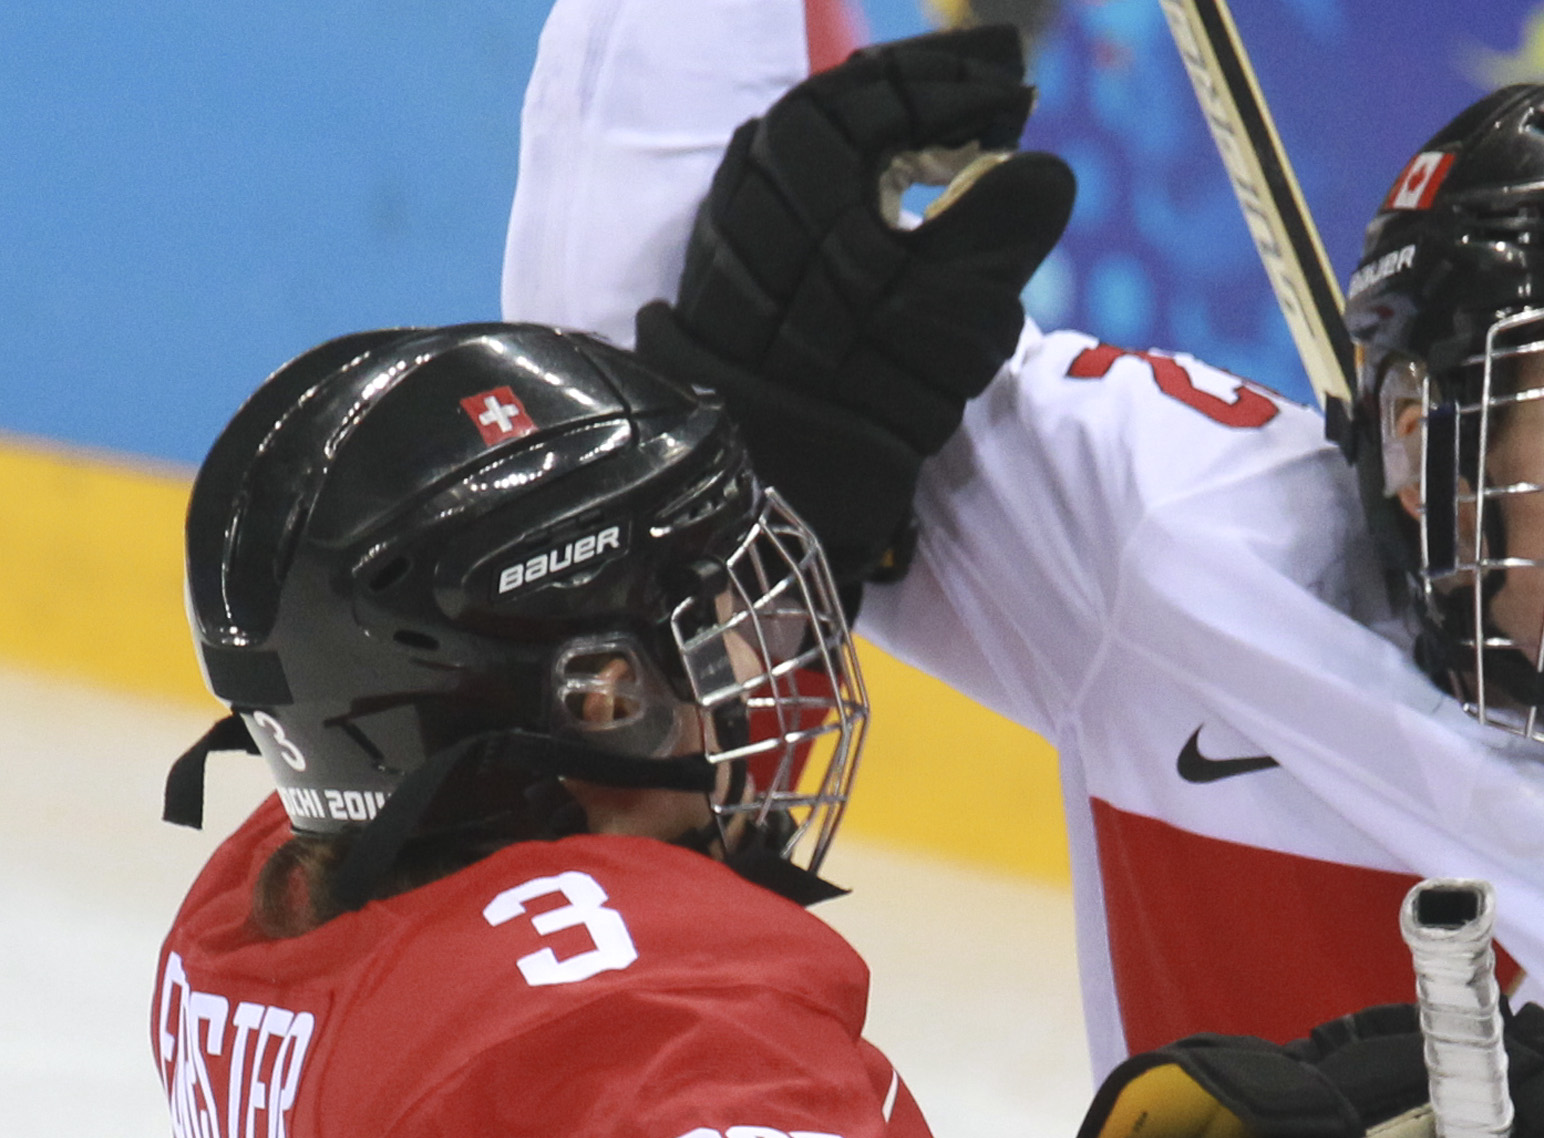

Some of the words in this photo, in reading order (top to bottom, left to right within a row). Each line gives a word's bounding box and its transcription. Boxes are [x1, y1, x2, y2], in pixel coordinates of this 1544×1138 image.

[498, 525, 620, 594] BAUER
[252, 710, 307, 772] 3
[483, 870, 639, 987] 3
